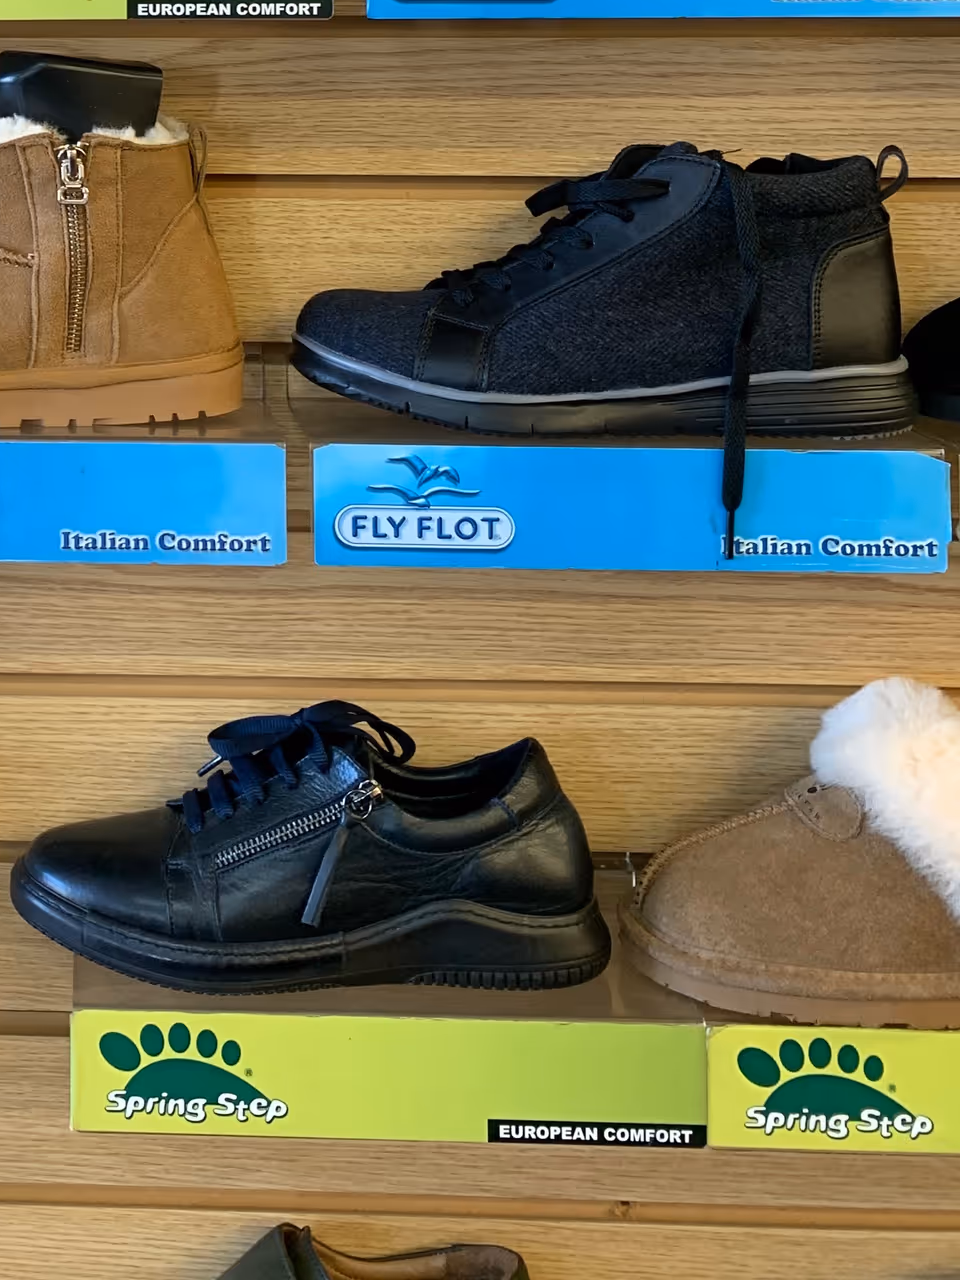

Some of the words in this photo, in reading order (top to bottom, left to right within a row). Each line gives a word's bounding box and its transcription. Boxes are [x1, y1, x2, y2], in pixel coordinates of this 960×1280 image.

[137, 3, 231, 16] EUROPEAN
[236, 2, 321, 16] COMFORT
[351, 515, 406, 539] FLY
[417, 516, 500, 540] FLOT
[61, 531, 149, 550] Italian
[158, 532, 271, 552] Comfort
[821, 537, 938, 557] Comfort
[105, 1089, 207, 1124] Spring
[213, 1092, 289, 1124] Step
[744, 1105, 850, 1140] Spring
[856, 1108, 934, 1140] Step
[498, 1124, 598, 1141] EUROPEAN
[603, 1127, 693, 1144] COMFORT
